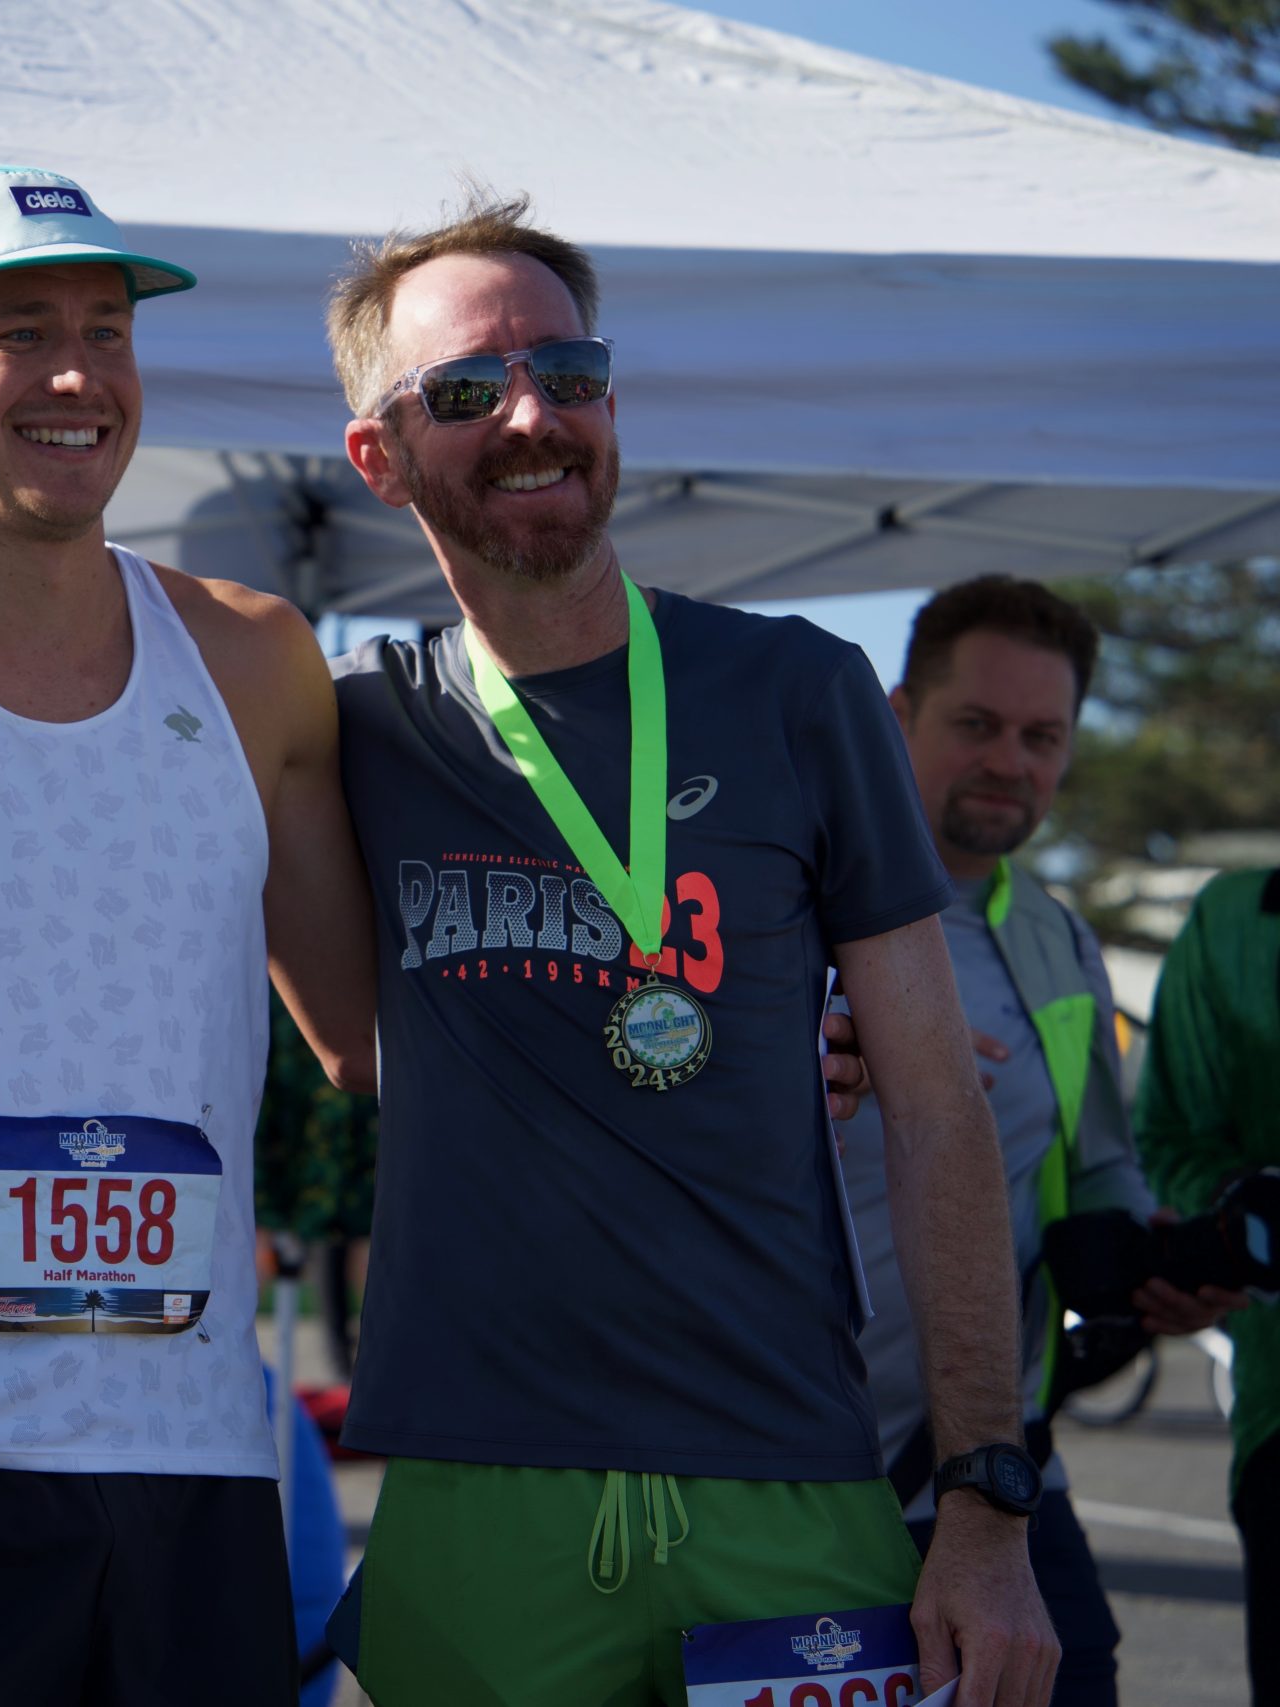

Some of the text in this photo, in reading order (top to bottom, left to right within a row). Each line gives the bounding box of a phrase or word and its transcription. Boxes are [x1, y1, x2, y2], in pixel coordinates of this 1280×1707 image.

[398, 859, 622, 971] PARIS
[603, 1025, 669, 1092] 2024
[59, 1132, 127, 1147] MOONLIGHT
[9, 1177, 177, 1266] 1558
[43, 1269, 136, 1283] Half Marathon
[791, 1630, 861, 1650] MOONLIGHT
